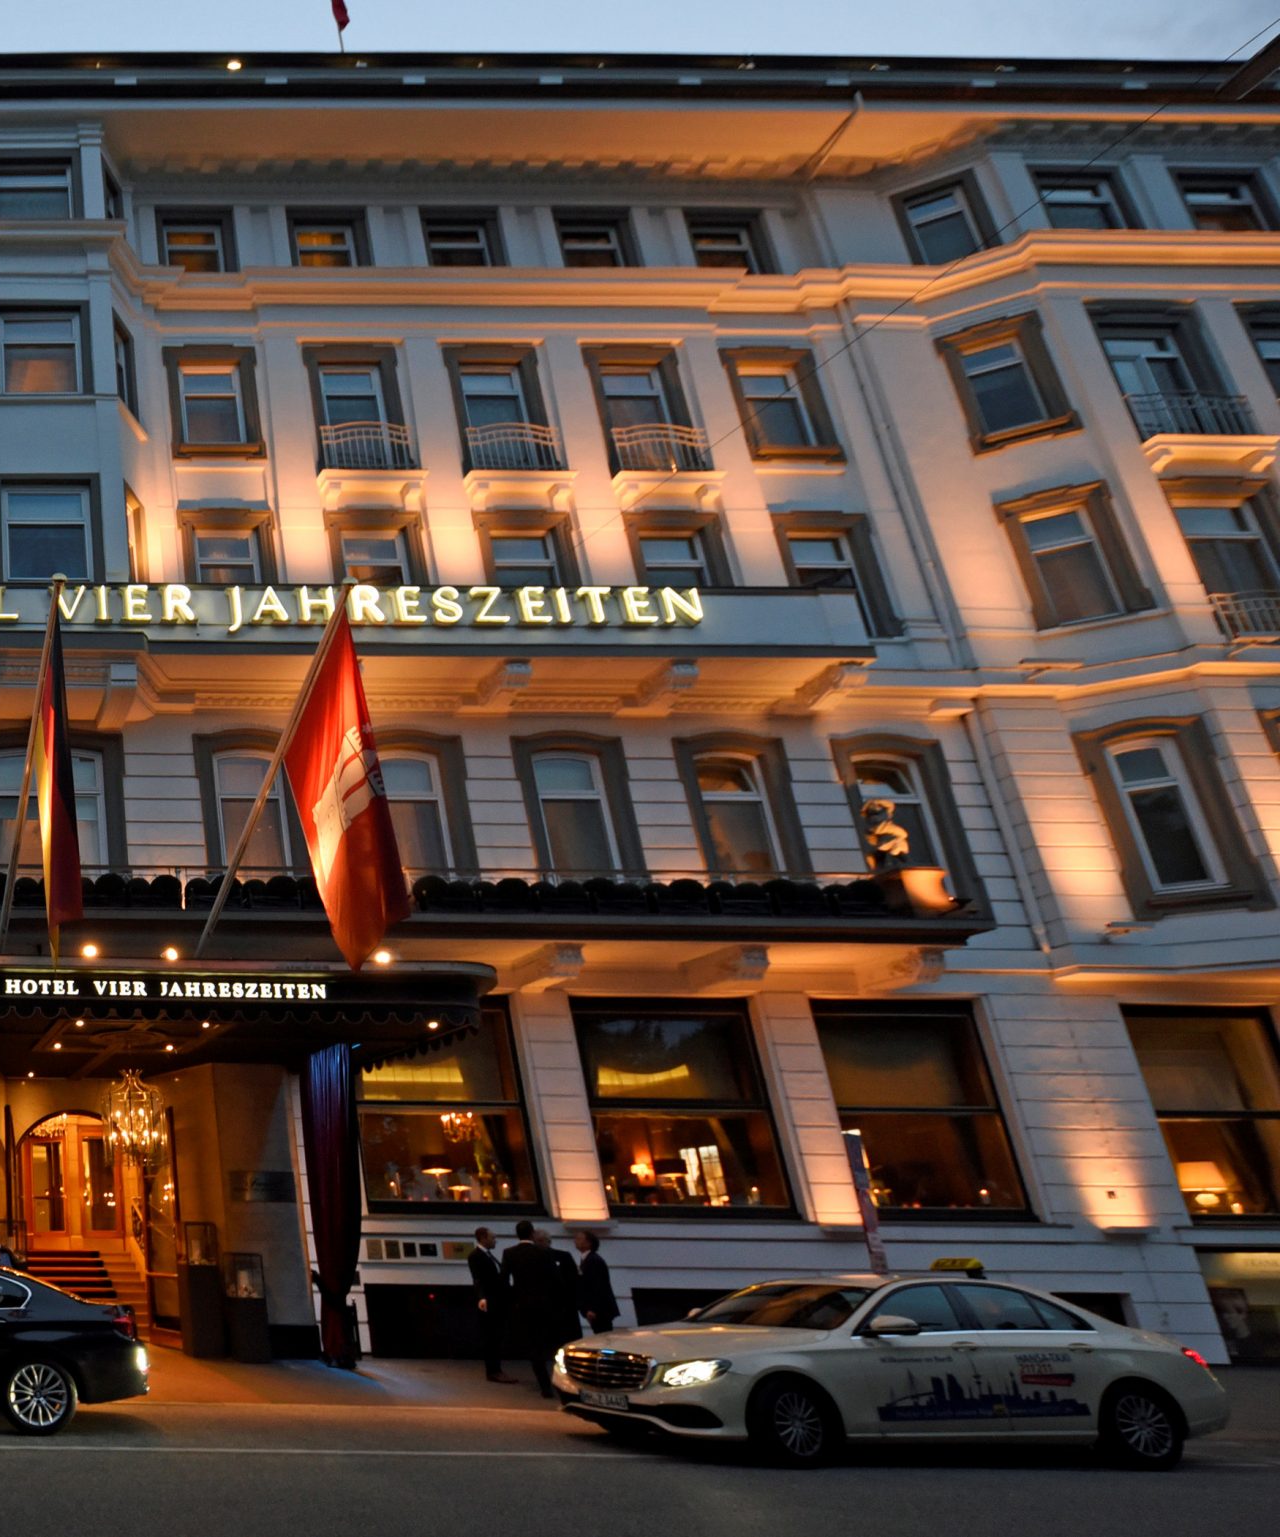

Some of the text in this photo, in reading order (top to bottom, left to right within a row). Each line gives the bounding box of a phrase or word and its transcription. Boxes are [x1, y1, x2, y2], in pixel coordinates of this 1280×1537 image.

[52, 583, 198, 625] VIER
[227, 584, 705, 632] JAHRESZEITEN
[5, 979, 327, 999] HOTEL VIER JAHRESZEITEN
